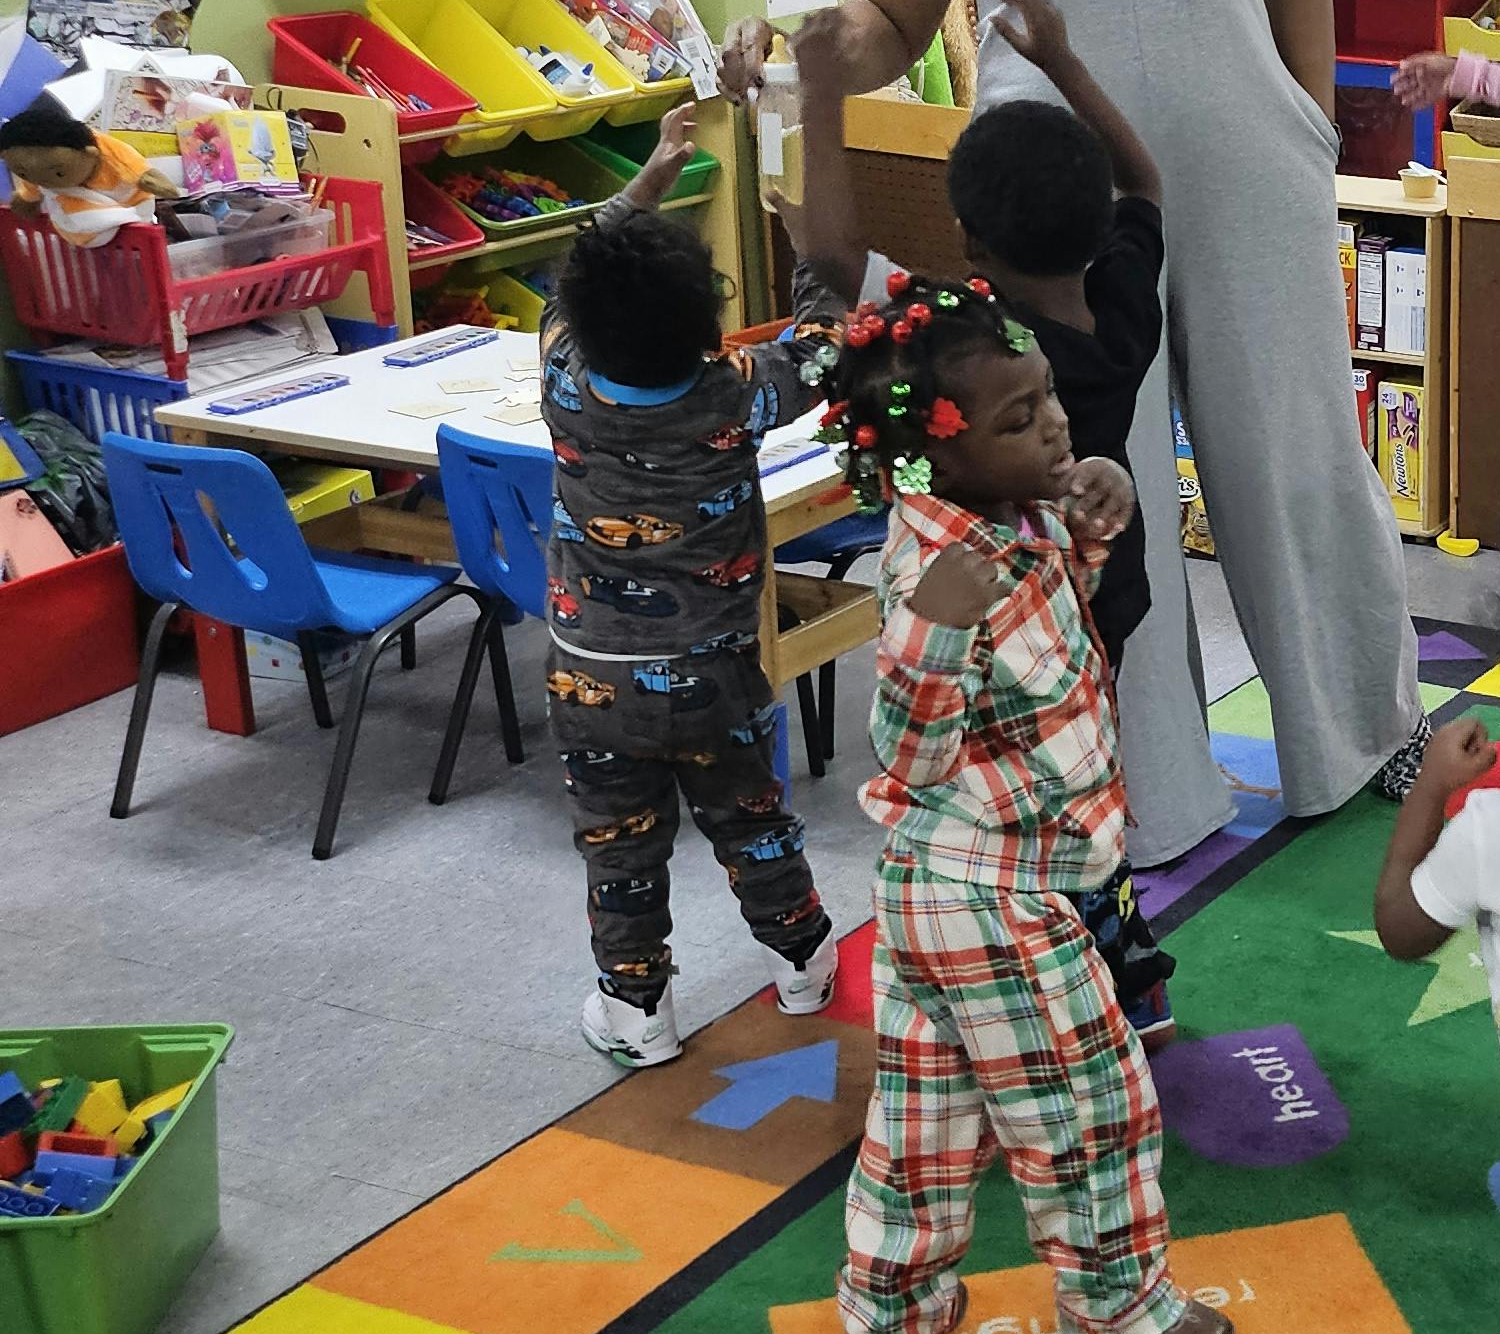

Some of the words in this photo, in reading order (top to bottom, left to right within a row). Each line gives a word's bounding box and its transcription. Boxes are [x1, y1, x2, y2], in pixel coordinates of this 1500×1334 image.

[1353, 375, 1365, 383] 30
[1393, 443, 1410, 497] Newtons
[1231, 1046, 1320, 1123] heart
[490, 1201, 642, 1263] V
